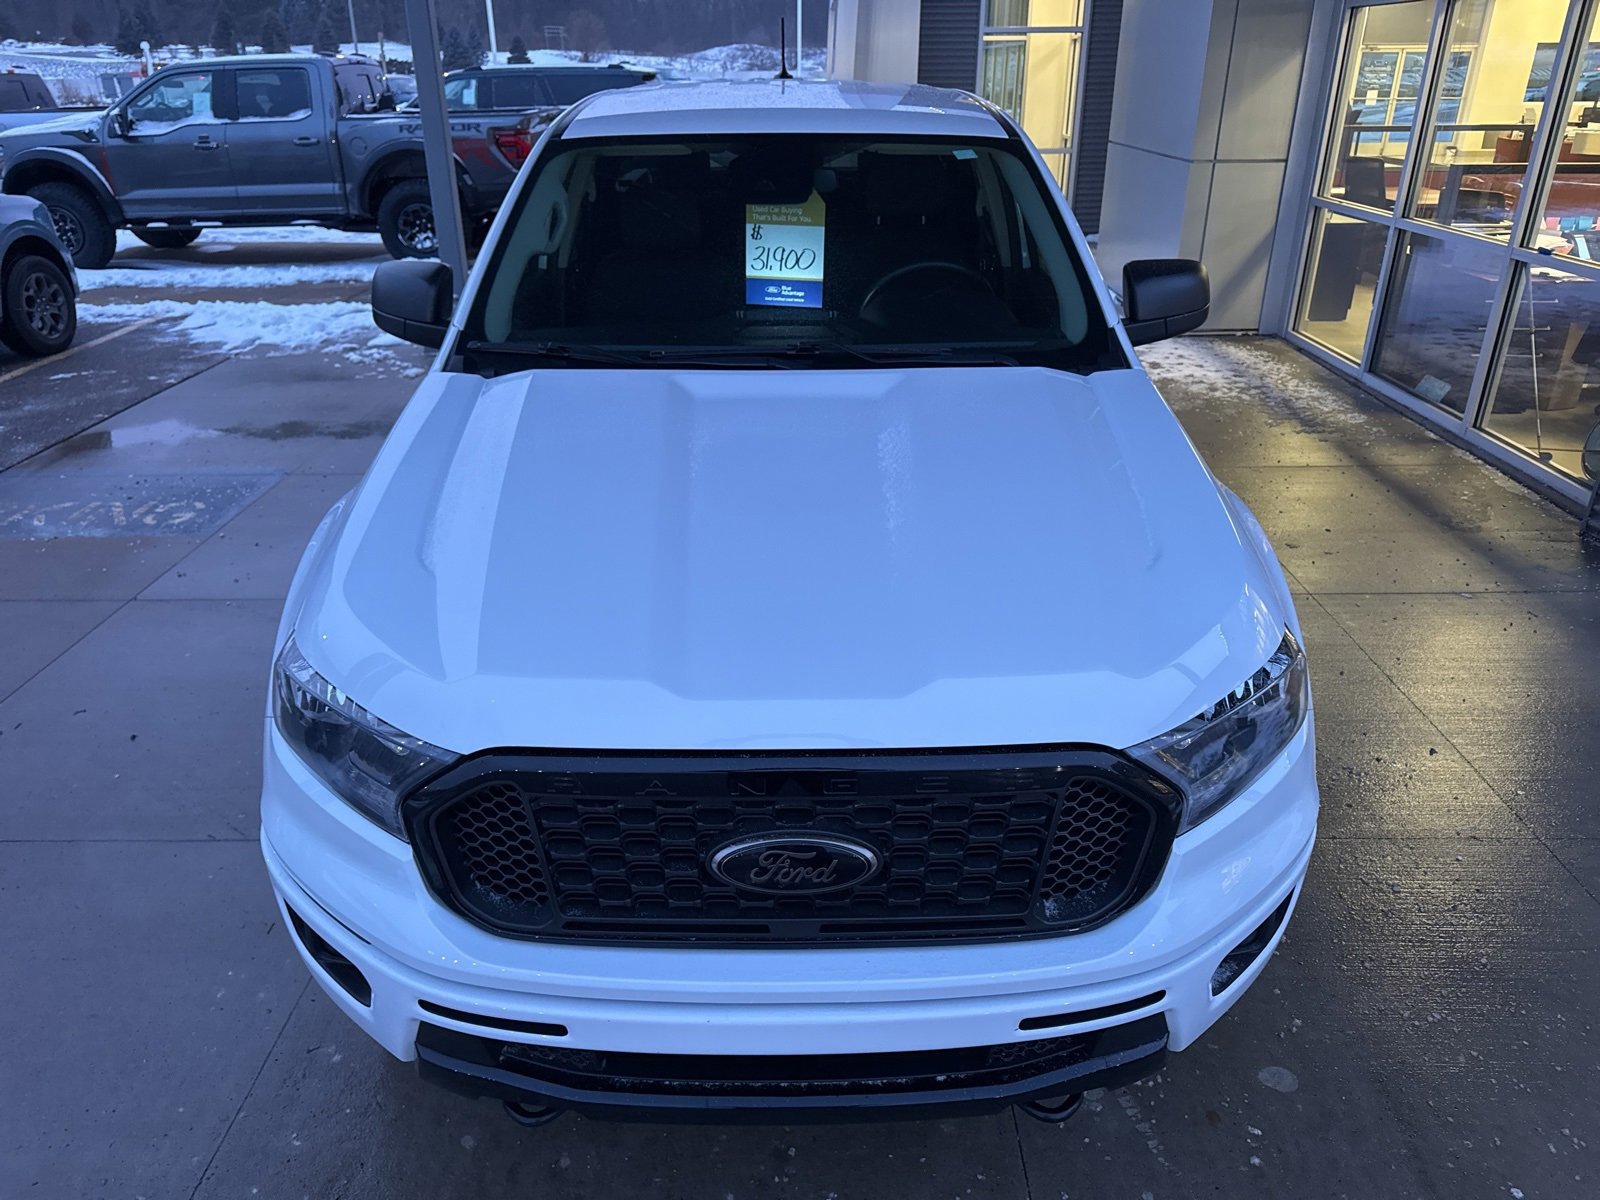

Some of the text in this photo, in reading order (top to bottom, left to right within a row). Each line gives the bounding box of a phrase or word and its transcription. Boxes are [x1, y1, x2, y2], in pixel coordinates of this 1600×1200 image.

[399, 123, 483, 135] RAOR
[751, 224, 763, 240] $
[547, 773, 1041, 795] RANGER
[750, 850, 839, 876] Ford
